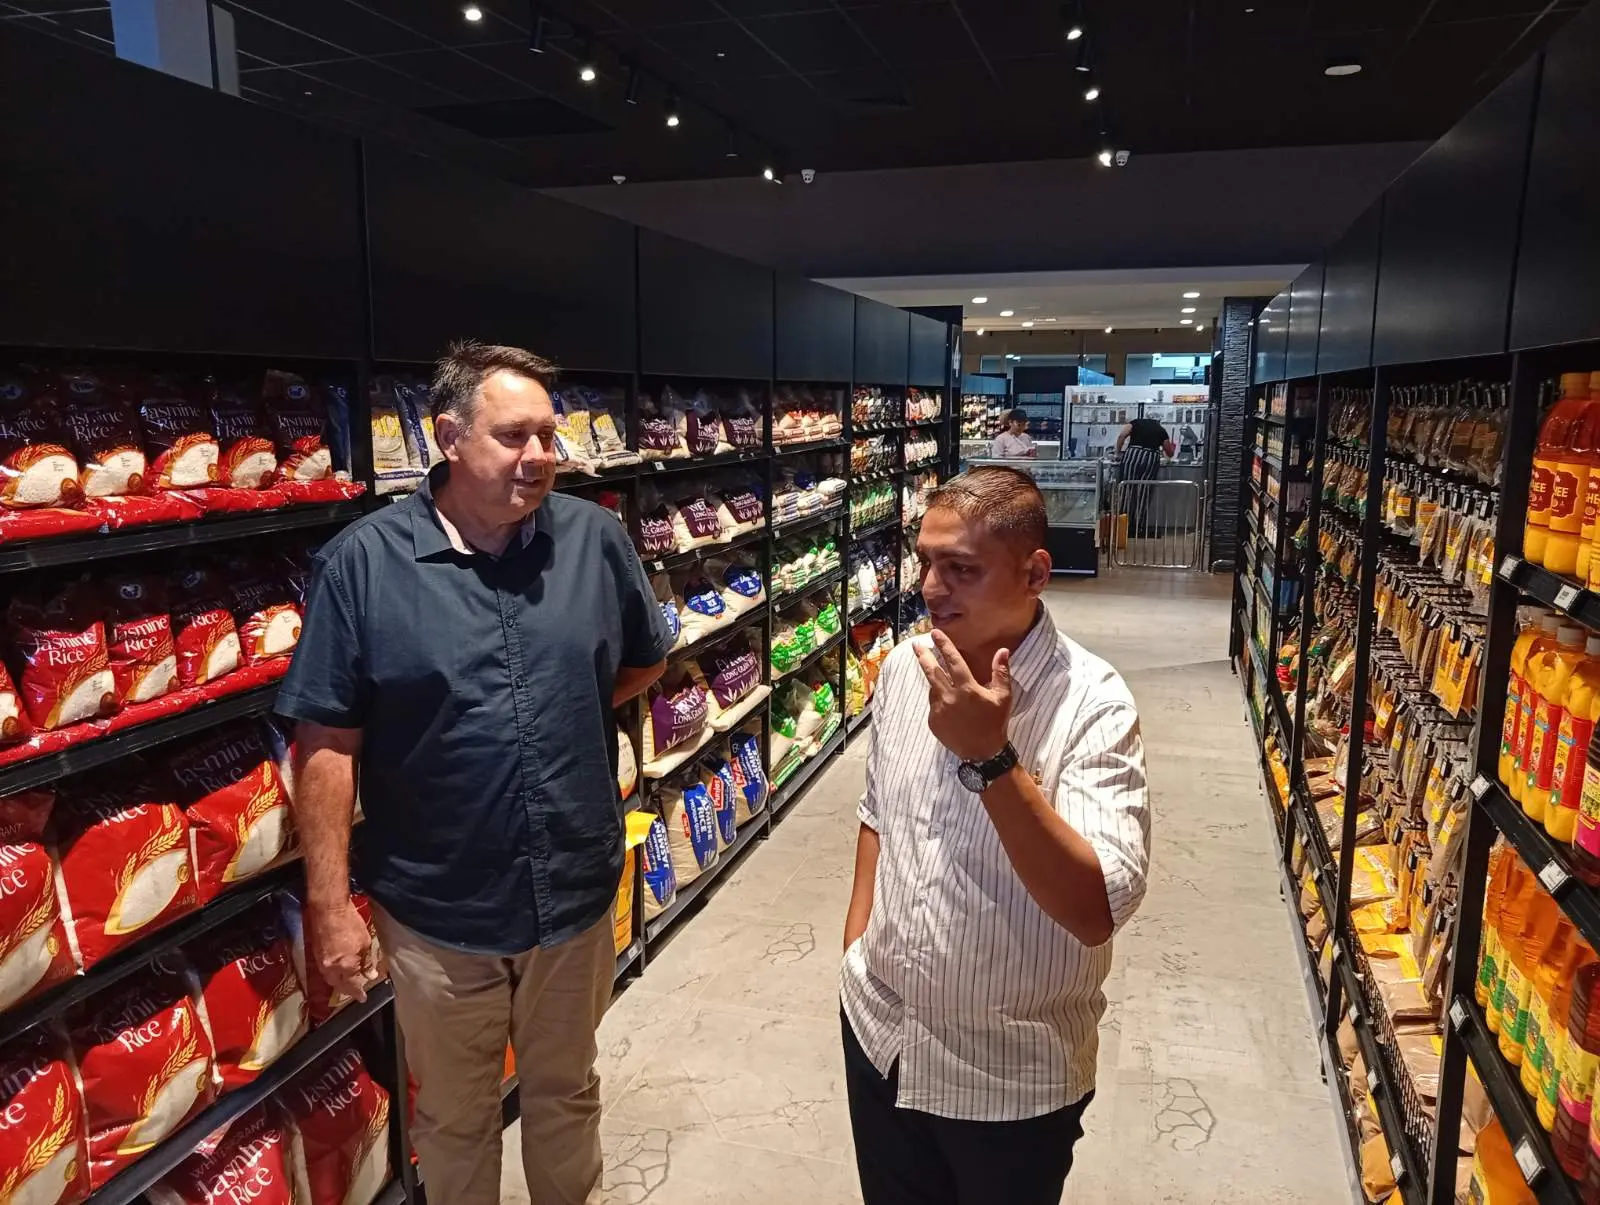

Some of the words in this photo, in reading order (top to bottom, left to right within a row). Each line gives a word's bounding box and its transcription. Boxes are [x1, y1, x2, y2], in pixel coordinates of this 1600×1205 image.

[112, 615, 169, 643] Jasmine
[191, 611, 219, 629] Rice
[34, 631, 97, 657] Jasmine
[49, 649, 86, 666] Rice
[124, 636, 158, 653] Rice
[697, 805, 707, 833] RICE
[117, 1019, 162, 1052] Rice
[324, 1080, 363, 1118] Rice
[197, 1128, 282, 1205] Jasmine
[229, 1165, 274, 1205] Rice
